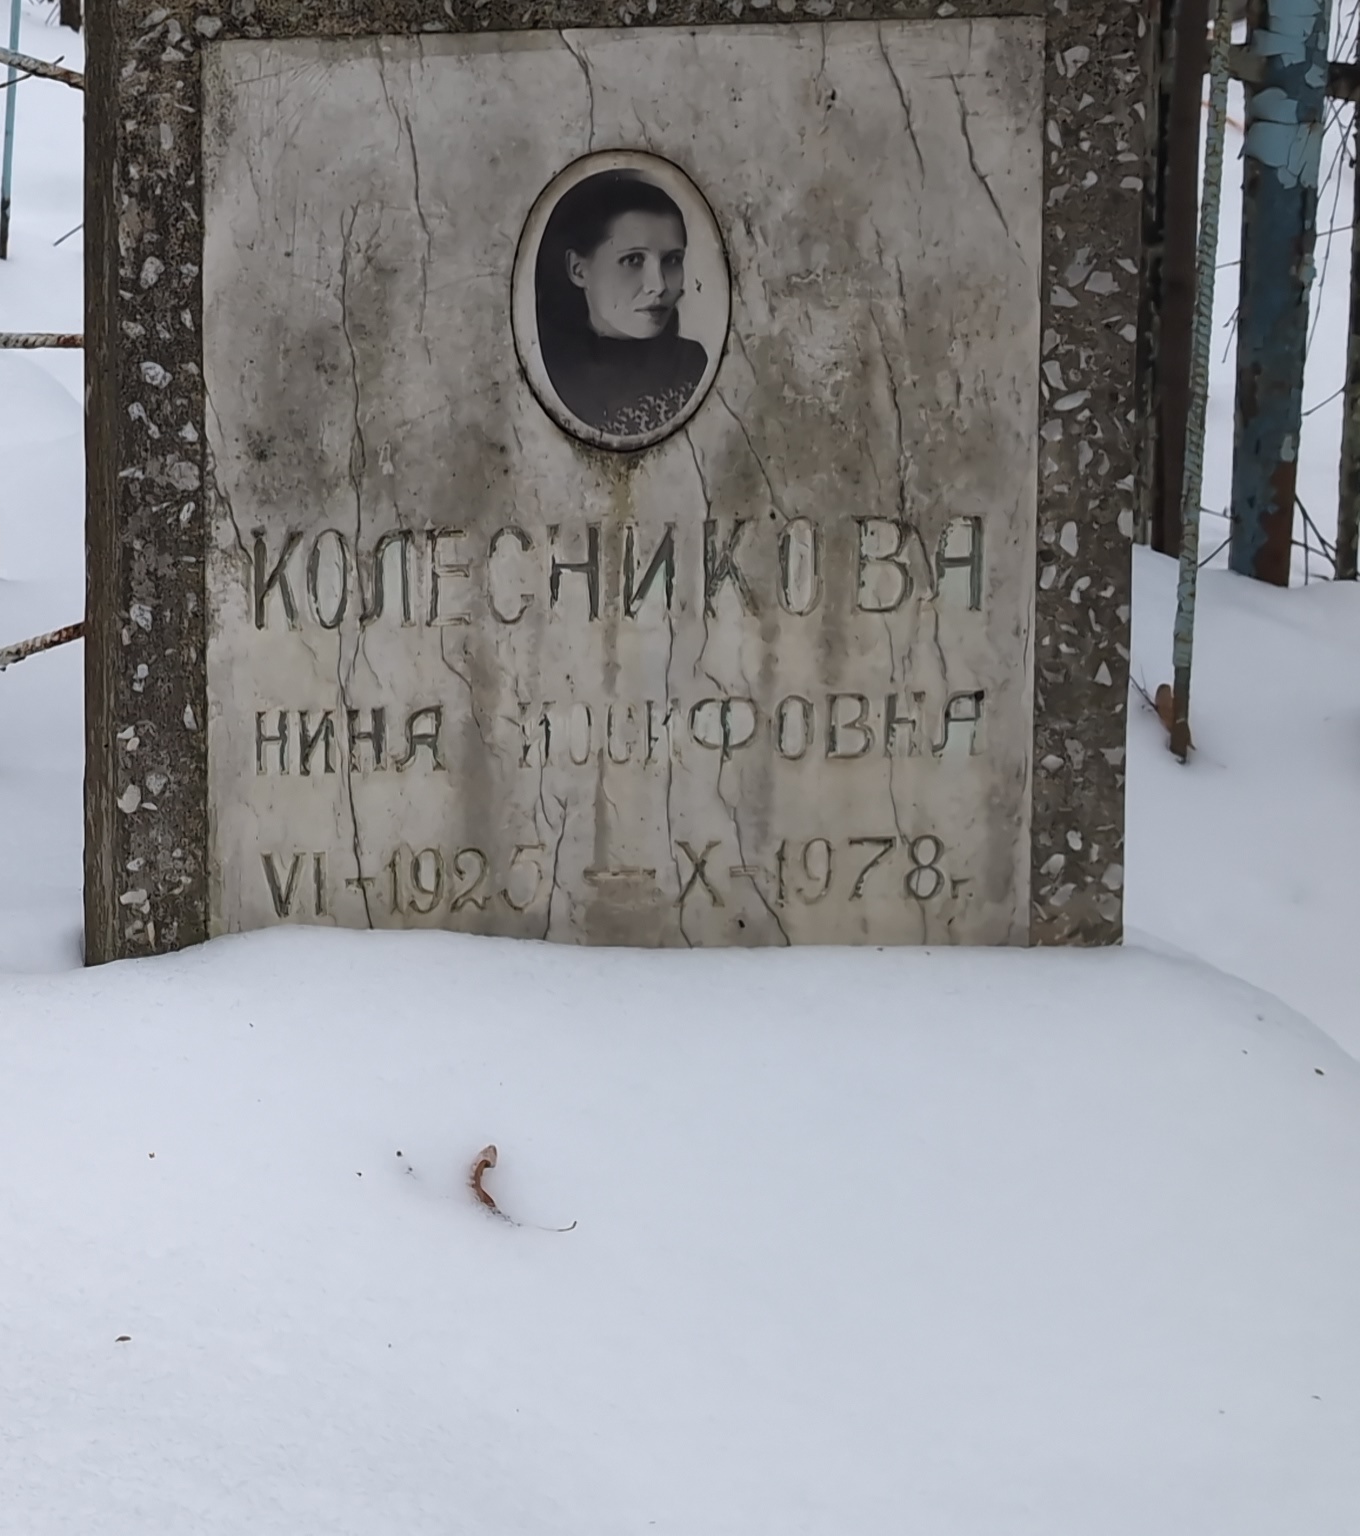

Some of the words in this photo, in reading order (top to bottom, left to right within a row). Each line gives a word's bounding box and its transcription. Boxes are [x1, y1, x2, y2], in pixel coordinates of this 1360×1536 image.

[250, 514, 987, 632] КОЛЕСНИКОВА
[254, 704, 449, 776] НИНА
[516, 689, 986, 769] ИОСИФОВНА
